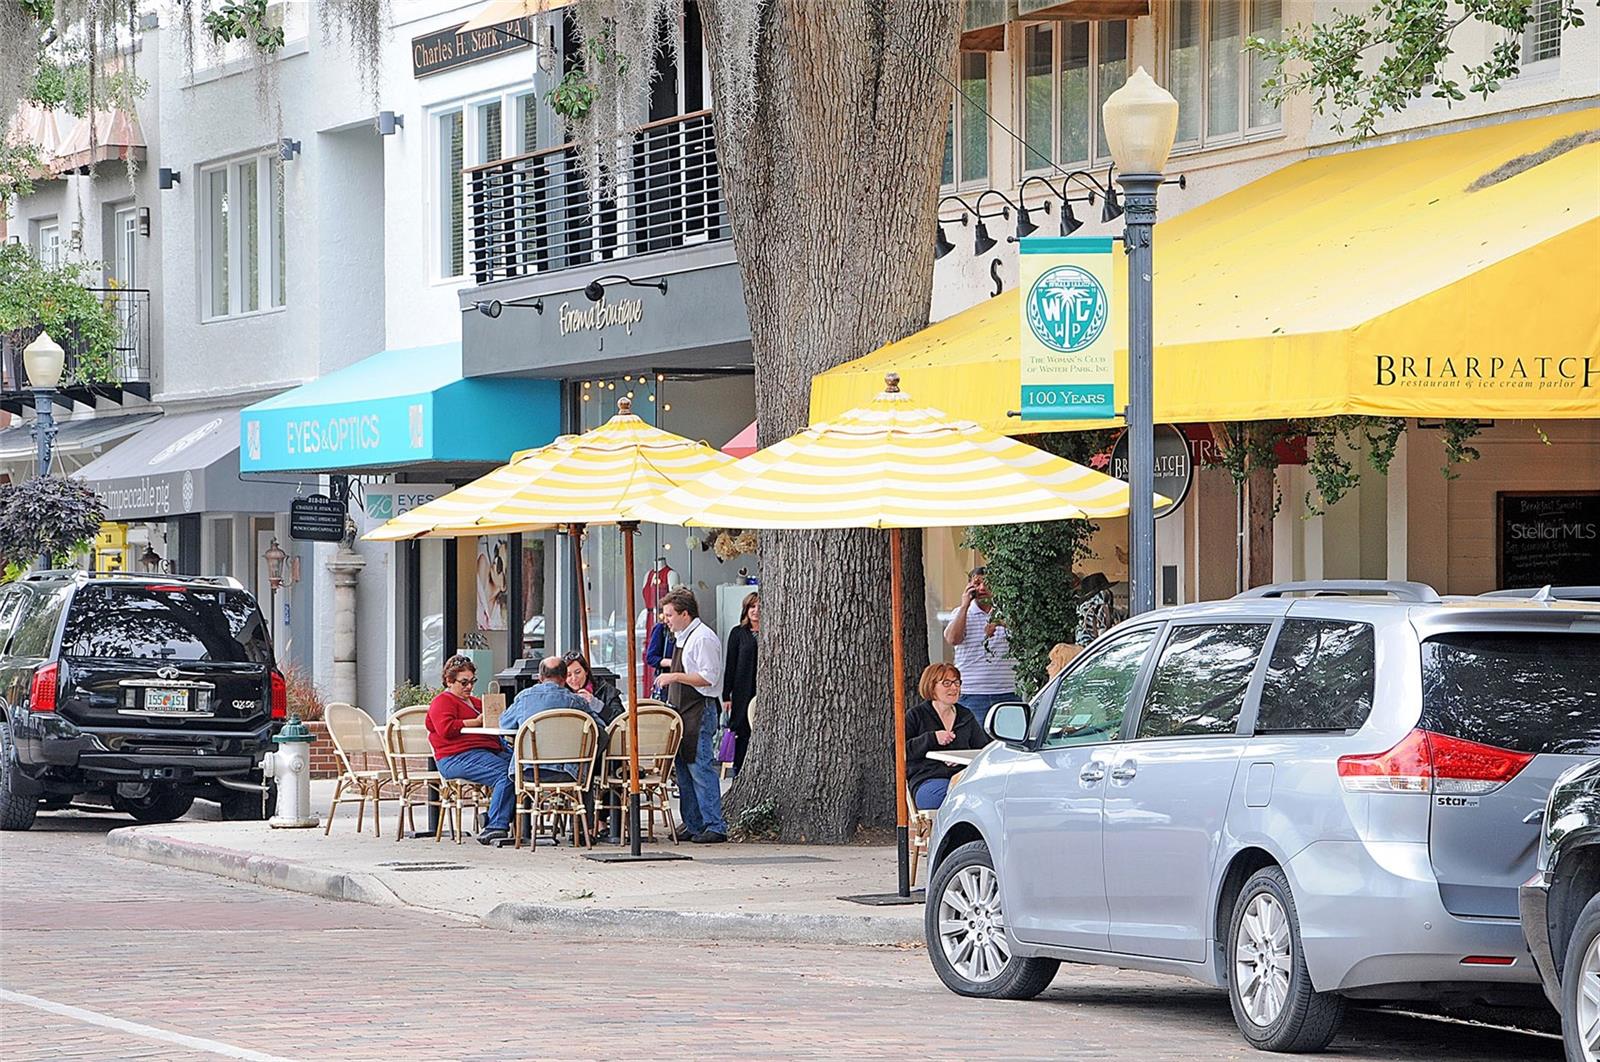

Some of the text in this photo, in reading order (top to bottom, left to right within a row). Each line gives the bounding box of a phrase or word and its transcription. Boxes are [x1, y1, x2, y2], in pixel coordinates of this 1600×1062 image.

[414, 39, 453, 69] Charles
[455, 33, 469, 57] H.
[471, 29, 503, 52] Stark,
[596, 296, 643, 336] Boutique
[1039, 365, 1068, 373] Winter
[1400, 379, 1461, 388] restaurant
[1478, 379, 1494, 388] ice
[1499, 380, 1533, 388] cream
[1538, 378, 1577, 390] parlor
[1029, 391, 1057, 405] 100
[155, 478, 170, 514] pig
[1437, 796, 1467, 806] star
